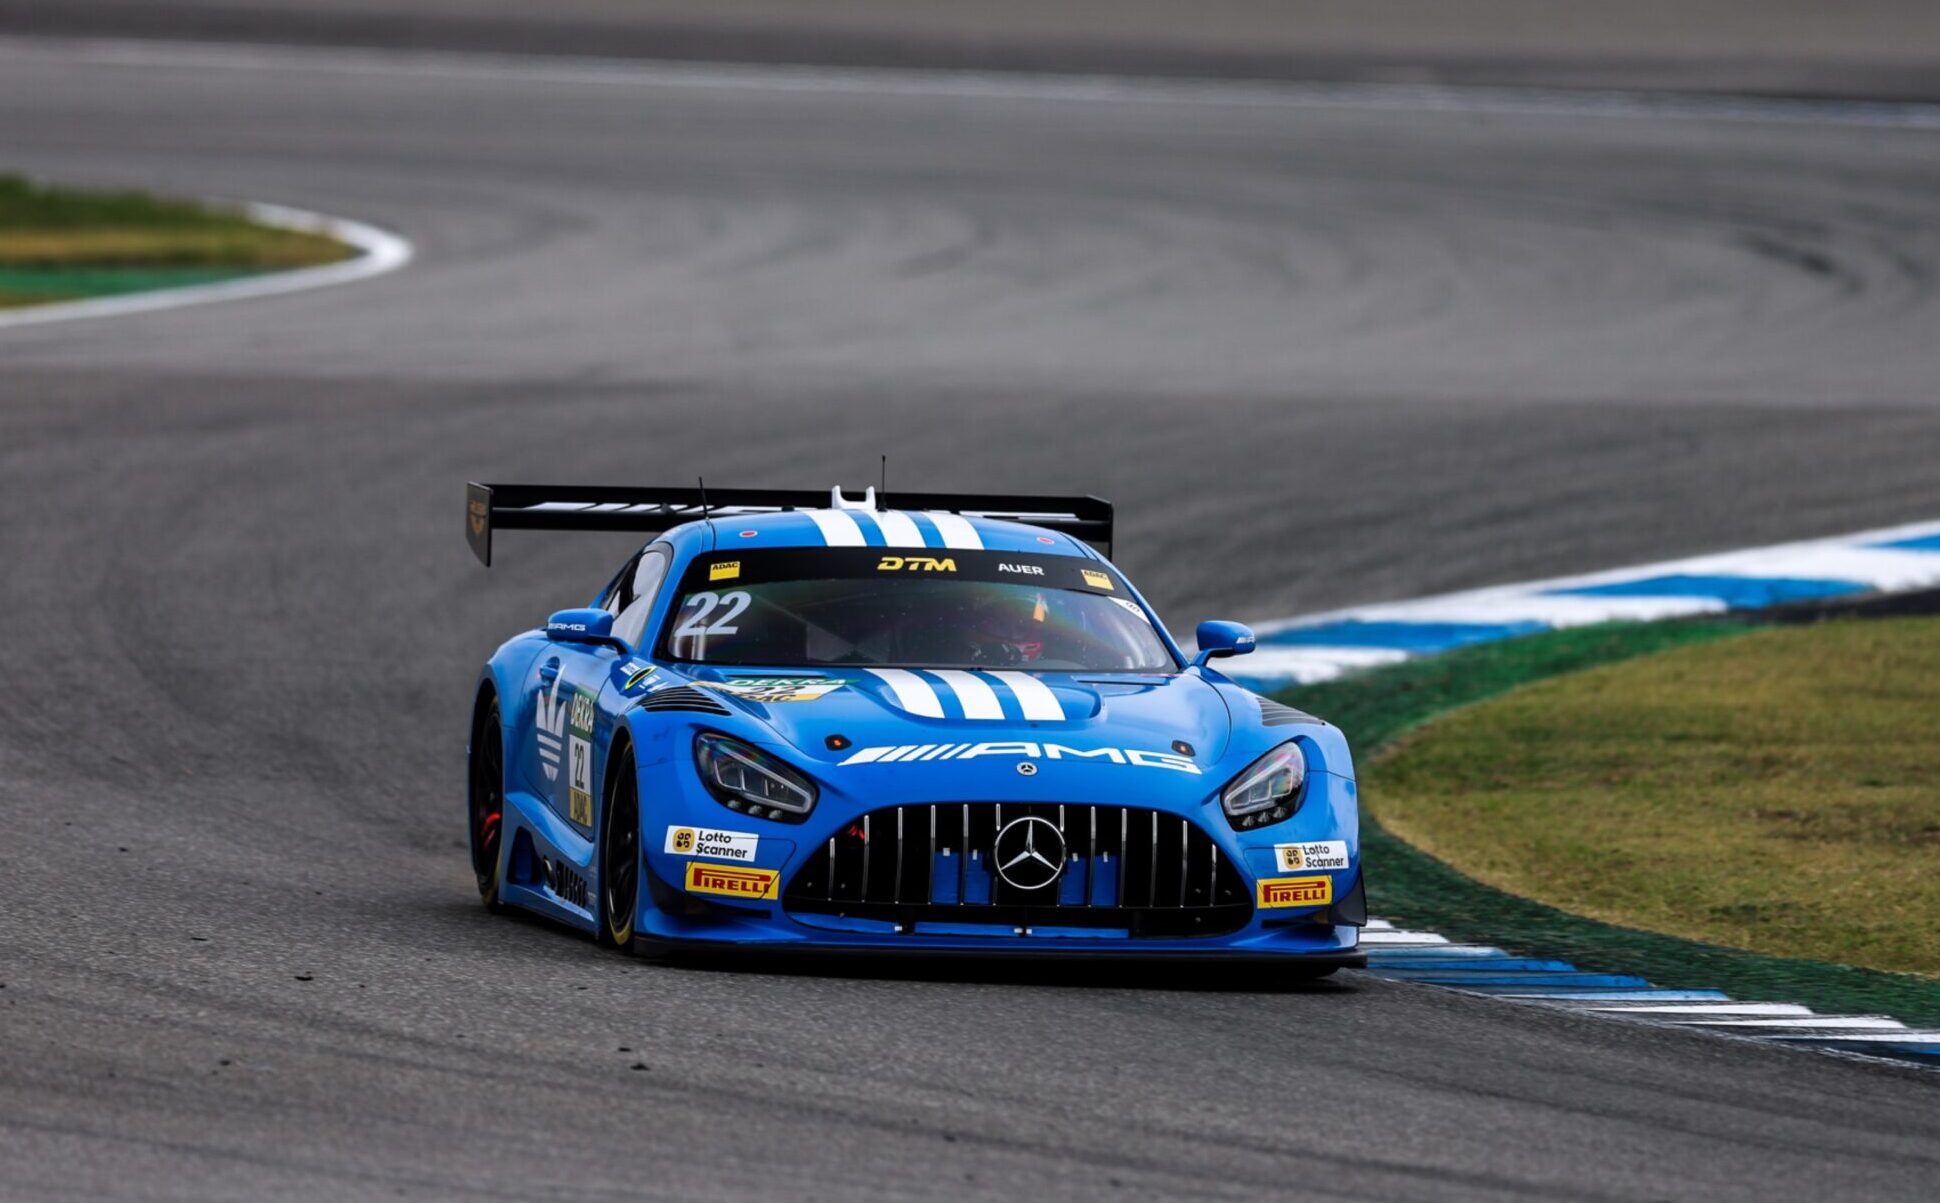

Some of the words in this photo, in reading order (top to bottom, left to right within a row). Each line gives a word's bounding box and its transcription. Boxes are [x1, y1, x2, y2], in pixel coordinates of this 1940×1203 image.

[877, 556, 957, 572] DTM
[998, 563, 1045, 576] AUER
[673, 590, 752, 637] 22
[555, 622, 586, 631] AMG
[726, 678, 846, 686] DEKRA
[743, 685, 806, 696] 22
[570, 691, 595, 733] DEKRA
[574, 742, 585, 789] 22
[956, 741, 1203, 775] AMG
[698, 830, 733, 844] Lotto
[695, 842, 749, 859] Scanner
[1302, 844, 1330, 856] Lotto
[1305, 857, 1344, 868] Scanner
[693, 867, 772, 894] PIRELLI
[1263, 881, 1326, 903] PIRELLI
